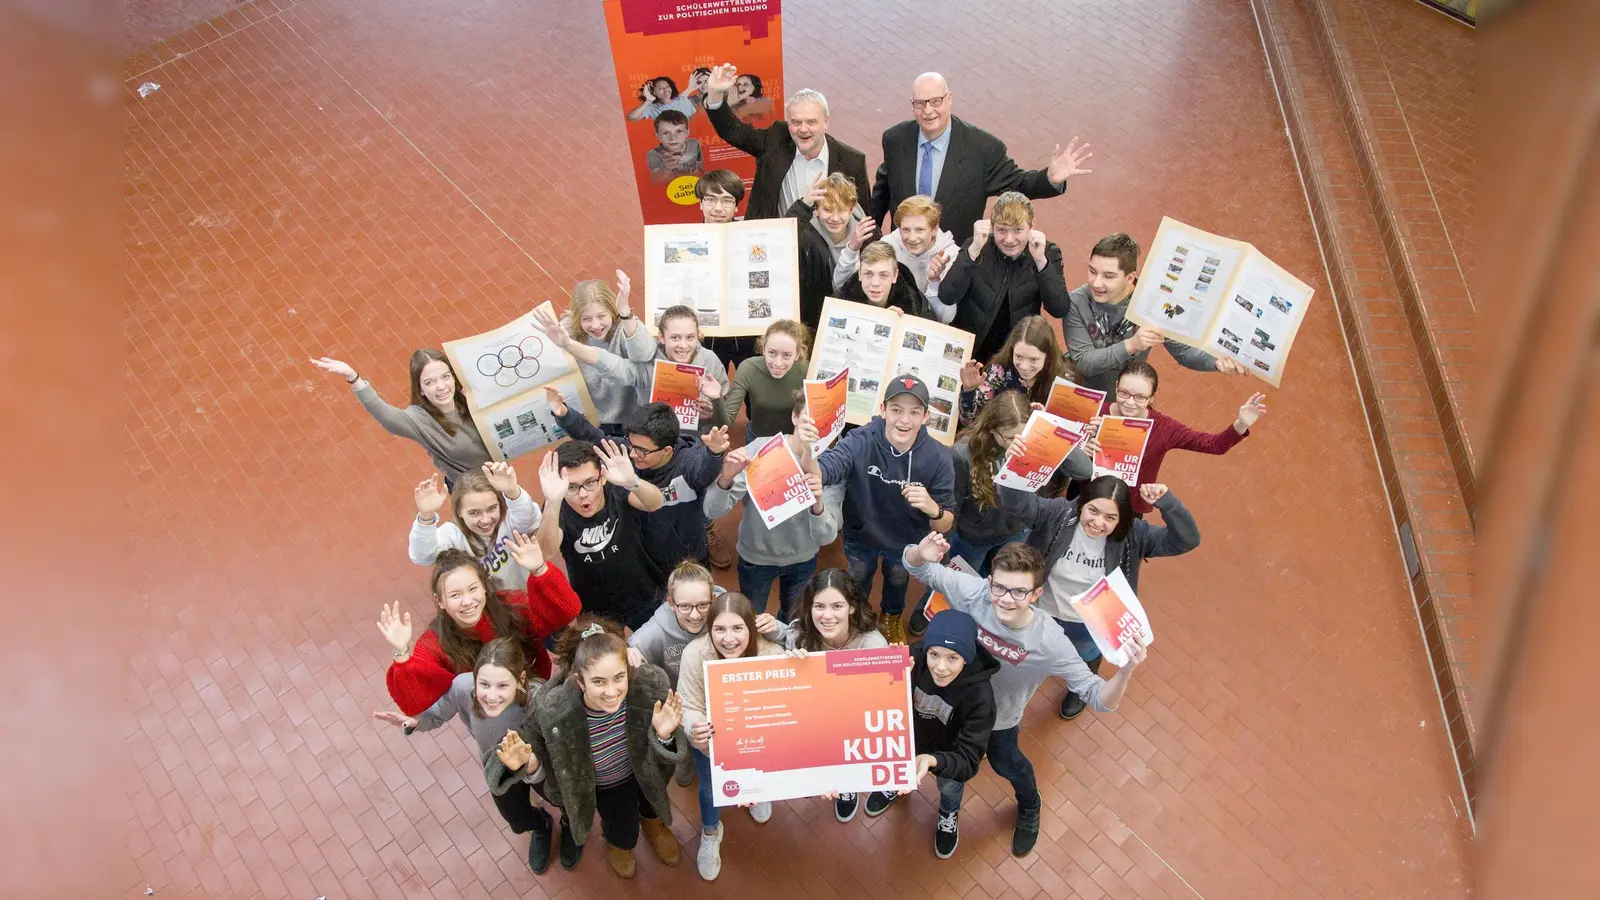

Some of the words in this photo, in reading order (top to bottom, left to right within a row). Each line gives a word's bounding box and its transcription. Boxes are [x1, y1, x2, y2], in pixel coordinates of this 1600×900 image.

[676, 8, 729, 19] POLITISCHEN
[731, 4, 768, 13] BILDUNG
[679, 183, 693, 191] Sei
[675, 406, 696, 416] KUN
[683, 416, 695, 425] DE
[1124, 454, 1139, 464] UR
[1039, 465, 1053, 475] UR
[1114, 462, 1137, 473] KUN
[1026, 470, 1047, 482] KUN
[1122, 472, 1135, 482] DE
[783, 481, 808, 501] KUN
[797, 491, 812, 505] DE
[581, 520, 611, 545] NIKE
[1116, 611, 1134, 629] UR
[1116, 619, 1141, 645] KUN
[977, 628, 1020, 660] Levi's
[722, 671, 763, 683] ERSTER
[765, 668, 796, 680] PREIS
[865, 709, 906, 732] UR
[844, 736, 906, 761] KUN
[872, 764, 908, 786] DE
